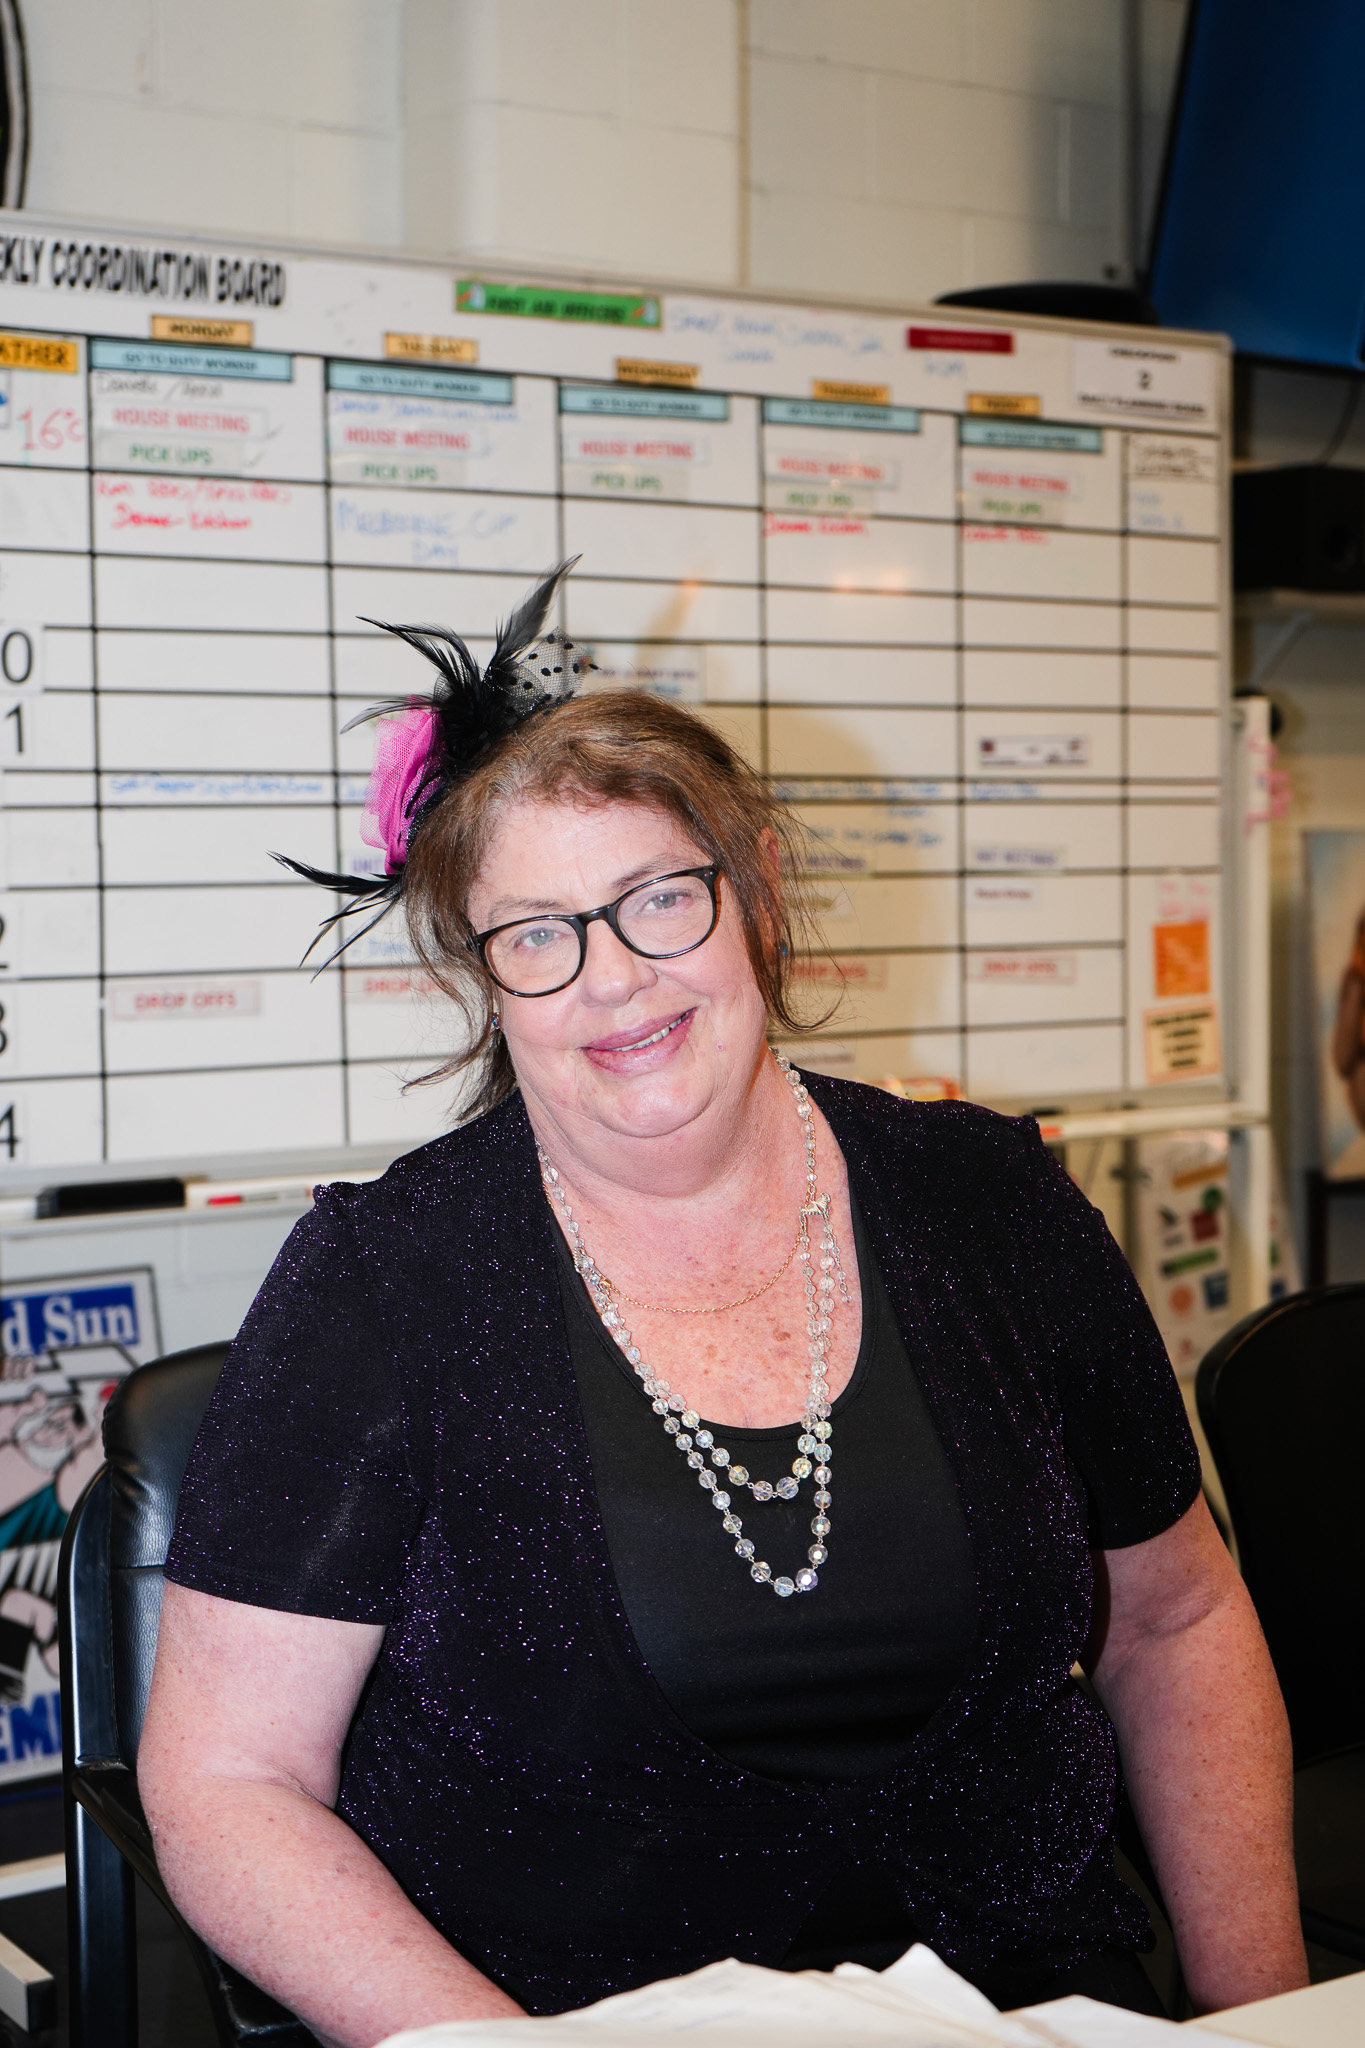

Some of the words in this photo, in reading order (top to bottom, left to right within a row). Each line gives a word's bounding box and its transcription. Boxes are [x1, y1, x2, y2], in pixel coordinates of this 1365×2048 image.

[51, 240, 210, 301] COORDINATION
[216, 256, 287, 308] BOARD
[1137, 369, 1151, 391] 2
[113, 407, 171, 427] HOUSE
[175, 411, 250, 433] MEETING
[346, 426, 397, 446] HOUSE
[402, 430, 471, 450] MEETING
[129, 444, 170, 462] PICK
[175, 447, 212, 465] UPS
[134, 993, 187, 1011] DROP
[192, 991, 237, 1009] OFFS
[43, 1296, 134, 1346] Sun
